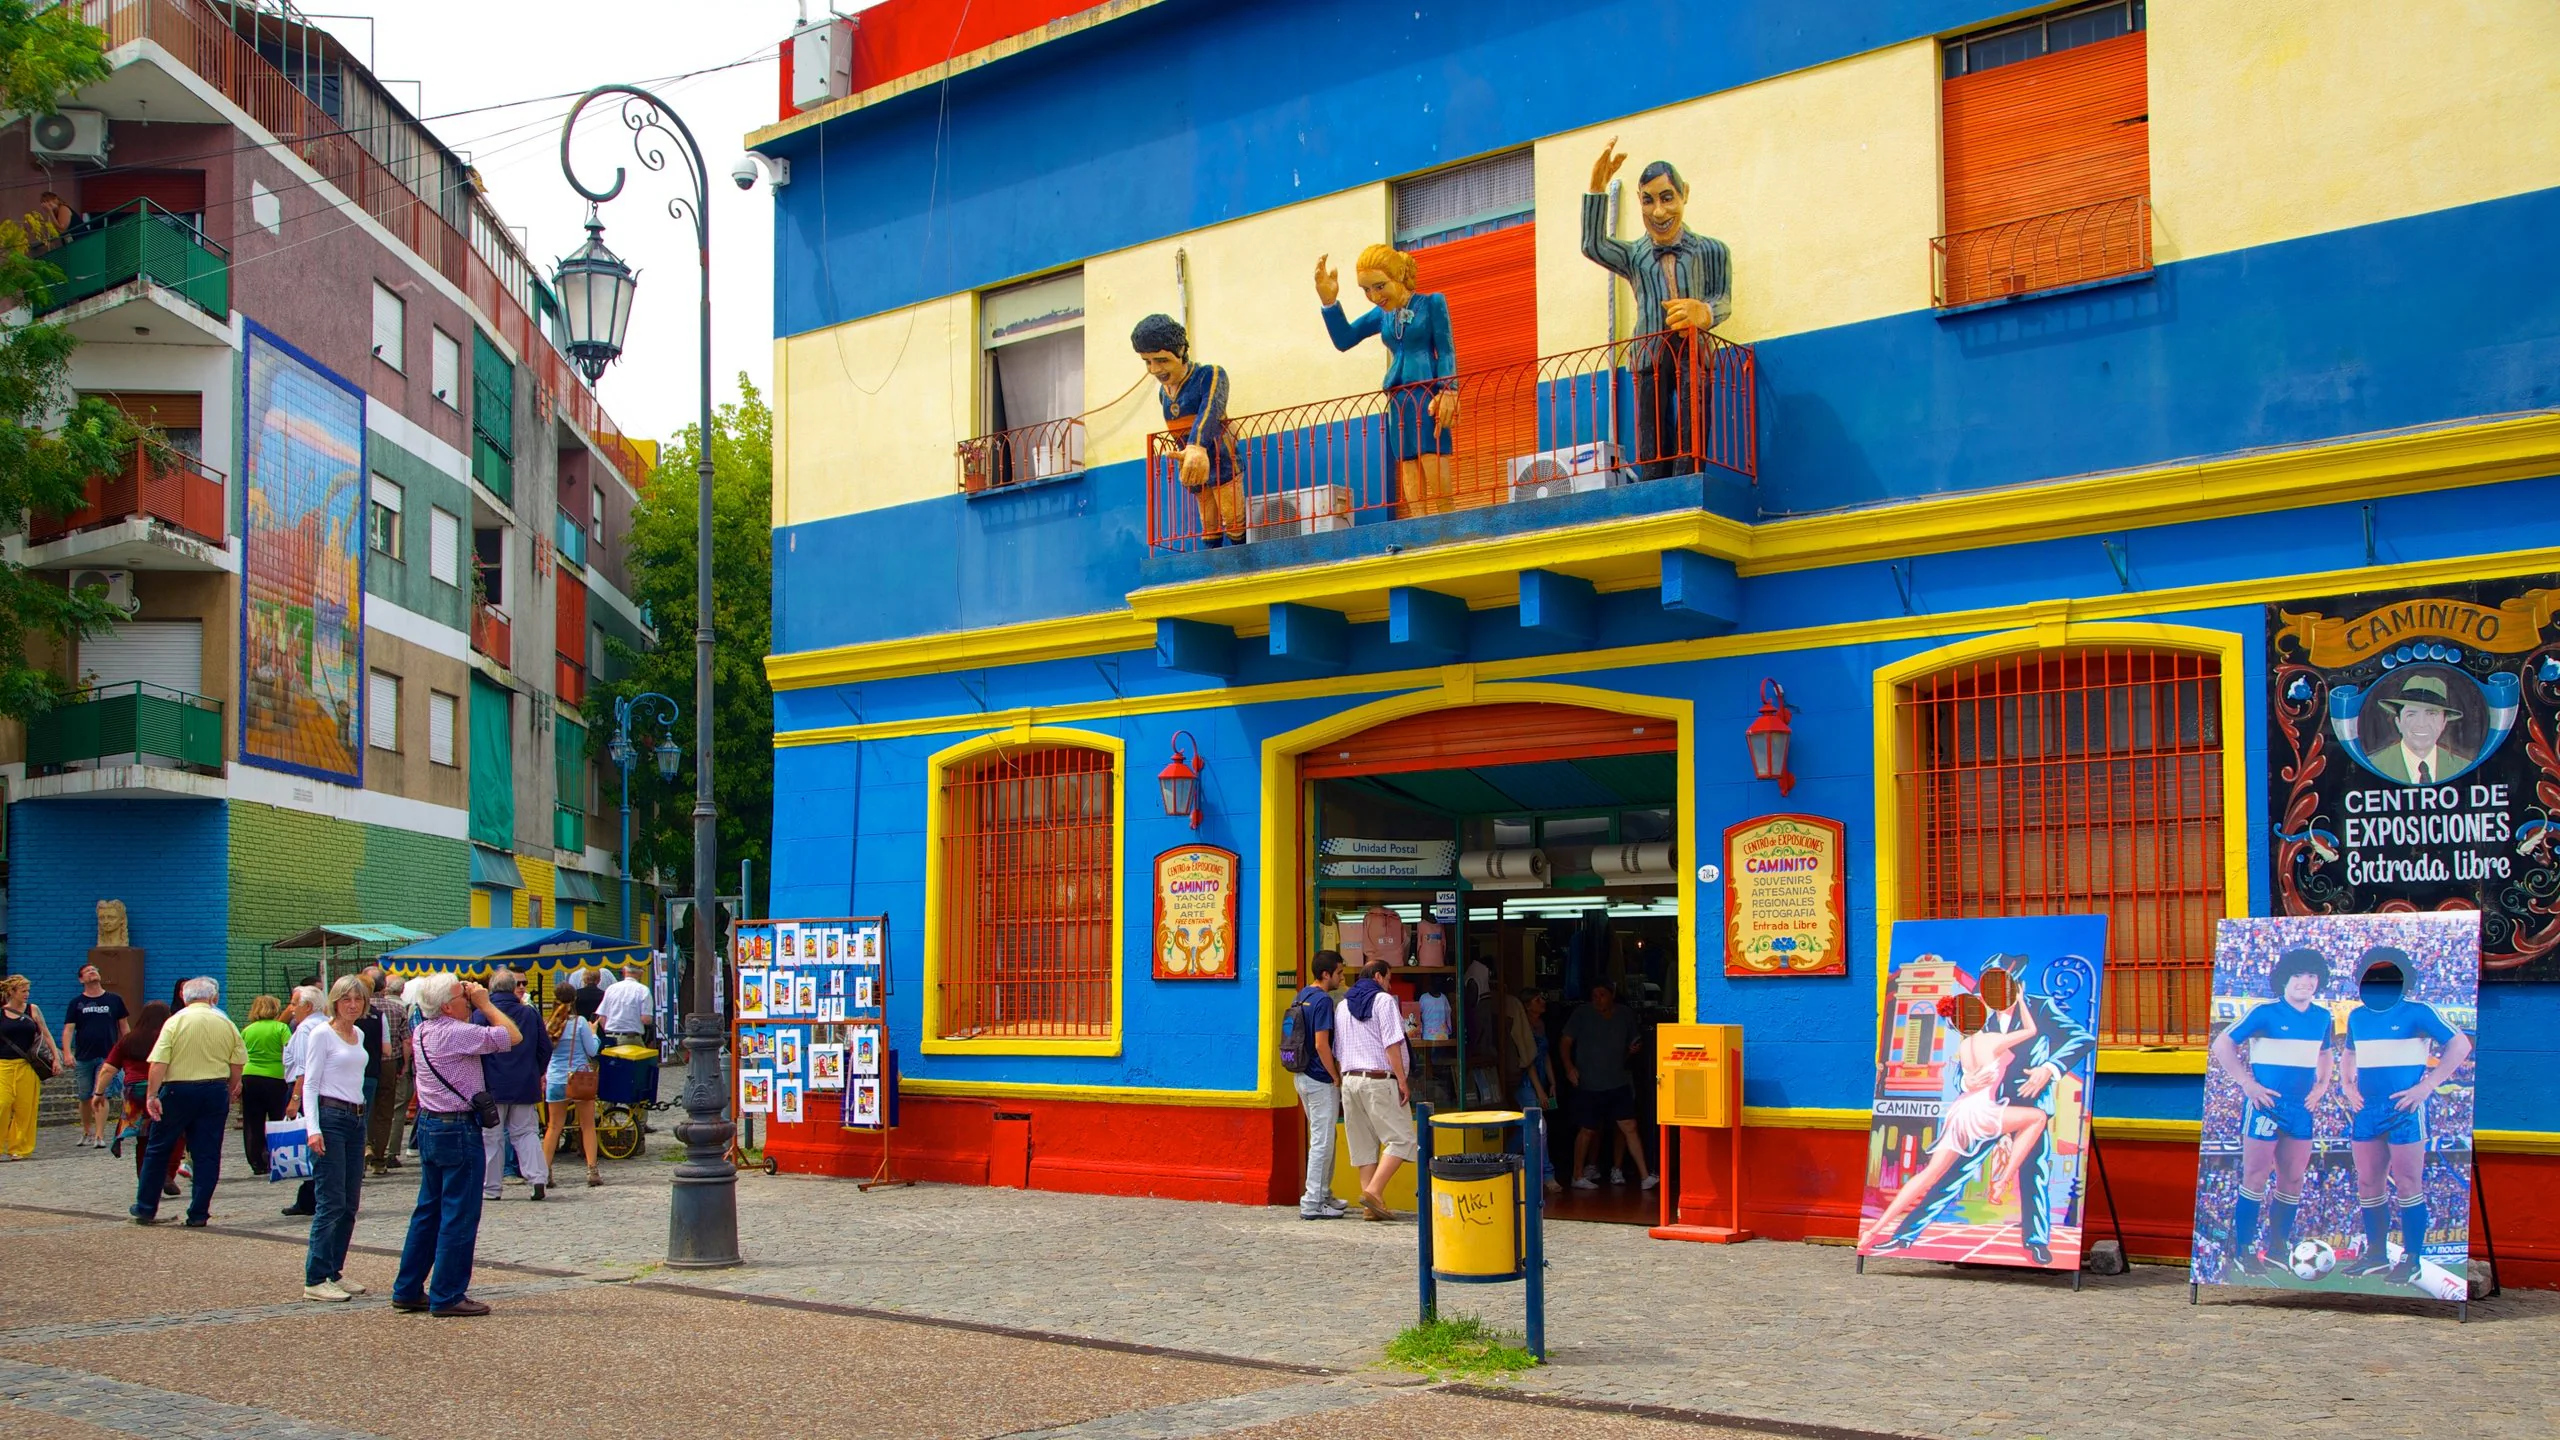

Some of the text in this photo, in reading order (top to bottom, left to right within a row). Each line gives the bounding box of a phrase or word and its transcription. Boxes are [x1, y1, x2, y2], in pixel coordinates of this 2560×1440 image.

[2346, 604, 2500, 653] CAMINITO
[2345, 784, 2509, 813] CENTRO DE
[2345, 812, 2511, 848] EXPOSICIONES
[1352, 842, 1418, 854] Unidad Postal
[1743, 834, 1824, 855] CENTRO de EXPOSICIONES
[1167, 863, 1186, 877] CENTRO
[1191, 861, 1224, 876] EXPOSICIONES
[1352, 864, 1418, 874] Unidad Postal
[1746, 857, 1818, 873] CAMINITO
[2347, 849, 2512, 886] Entrada libre
[1170, 880, 1220, 894] CAMINITO
[1753, 875, 1813, 886] SOUVENIRS
[1175, 893, 1215, 901] TANGO
[1752, 886, 1816, 897] ARTESANIAS
[1752, 897, 1815, 908] REGIONALES
[1752, 908, 1816, 919] FOTOGRAFIA
[1753, 920, 1818, 931] Entrada Libre
[1671, 1050, 1710, 1061] DHL
[1876, 1102, 1941, 1116] CAMINITO
